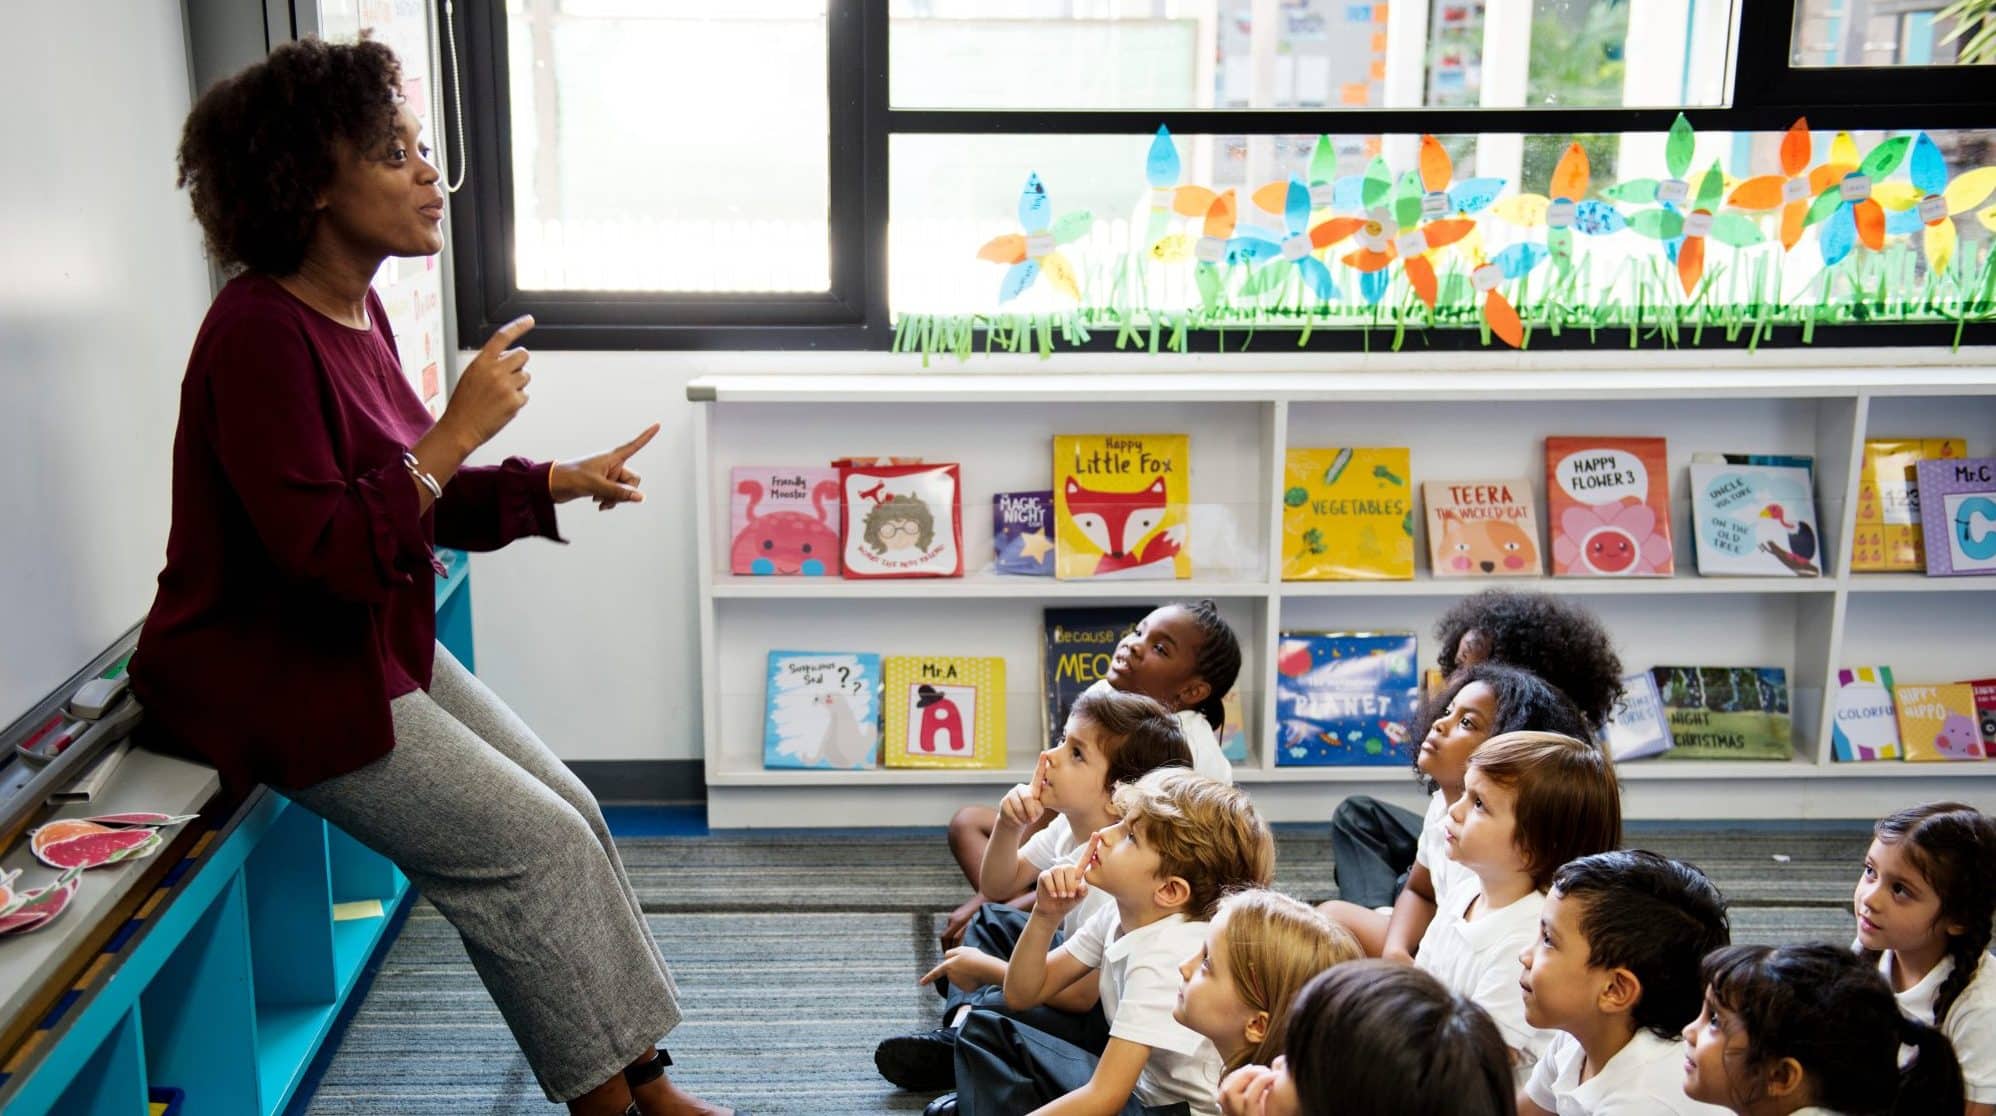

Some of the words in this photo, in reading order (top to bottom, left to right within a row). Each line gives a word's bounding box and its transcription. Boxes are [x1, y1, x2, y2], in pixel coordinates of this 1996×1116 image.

[1105, 436, 1142, 453] Happy
[1076, 451, 1131, 474] Little
[1140, 453, 1173, 474] Fox
[1573, 456, 1616, 473] HAPPY
[1571, 473, 1624, 490] FLOWER
[1626, 469, 1636, 484] 3
[1709, 477, 1745, 499] UNCLE
[1000, 497, 1041, 511] MAGIC
[1448, 486, 1514, 506] TEERA
[1311, 499, 1403, 516] VEGETABLES
[1460, 507, 1504, 519] WICKED
[1507, 506, 1527, 518] CAT
[1004, 509, 1046, 526] NIGHT
[1711, 518, 1727, 528] ON
[1732, 522, 1749, 534] THE
[1717, 530, 1741, 543] OLD
[1714, 538, 1739, 554] TREE
[1054, 625, 1114, 643] Because
[1055, 653, 1112, 683] MEO
[1294, 692, 1392, 719] PLANET
[1838, 704, 1896, 721] COLORFU
[1903, 703, 1946, 721] HIPPO
[1671, 712, 1710, 726] NIGHT
[1673, 734, 1745, 749] CHRISTMAS
